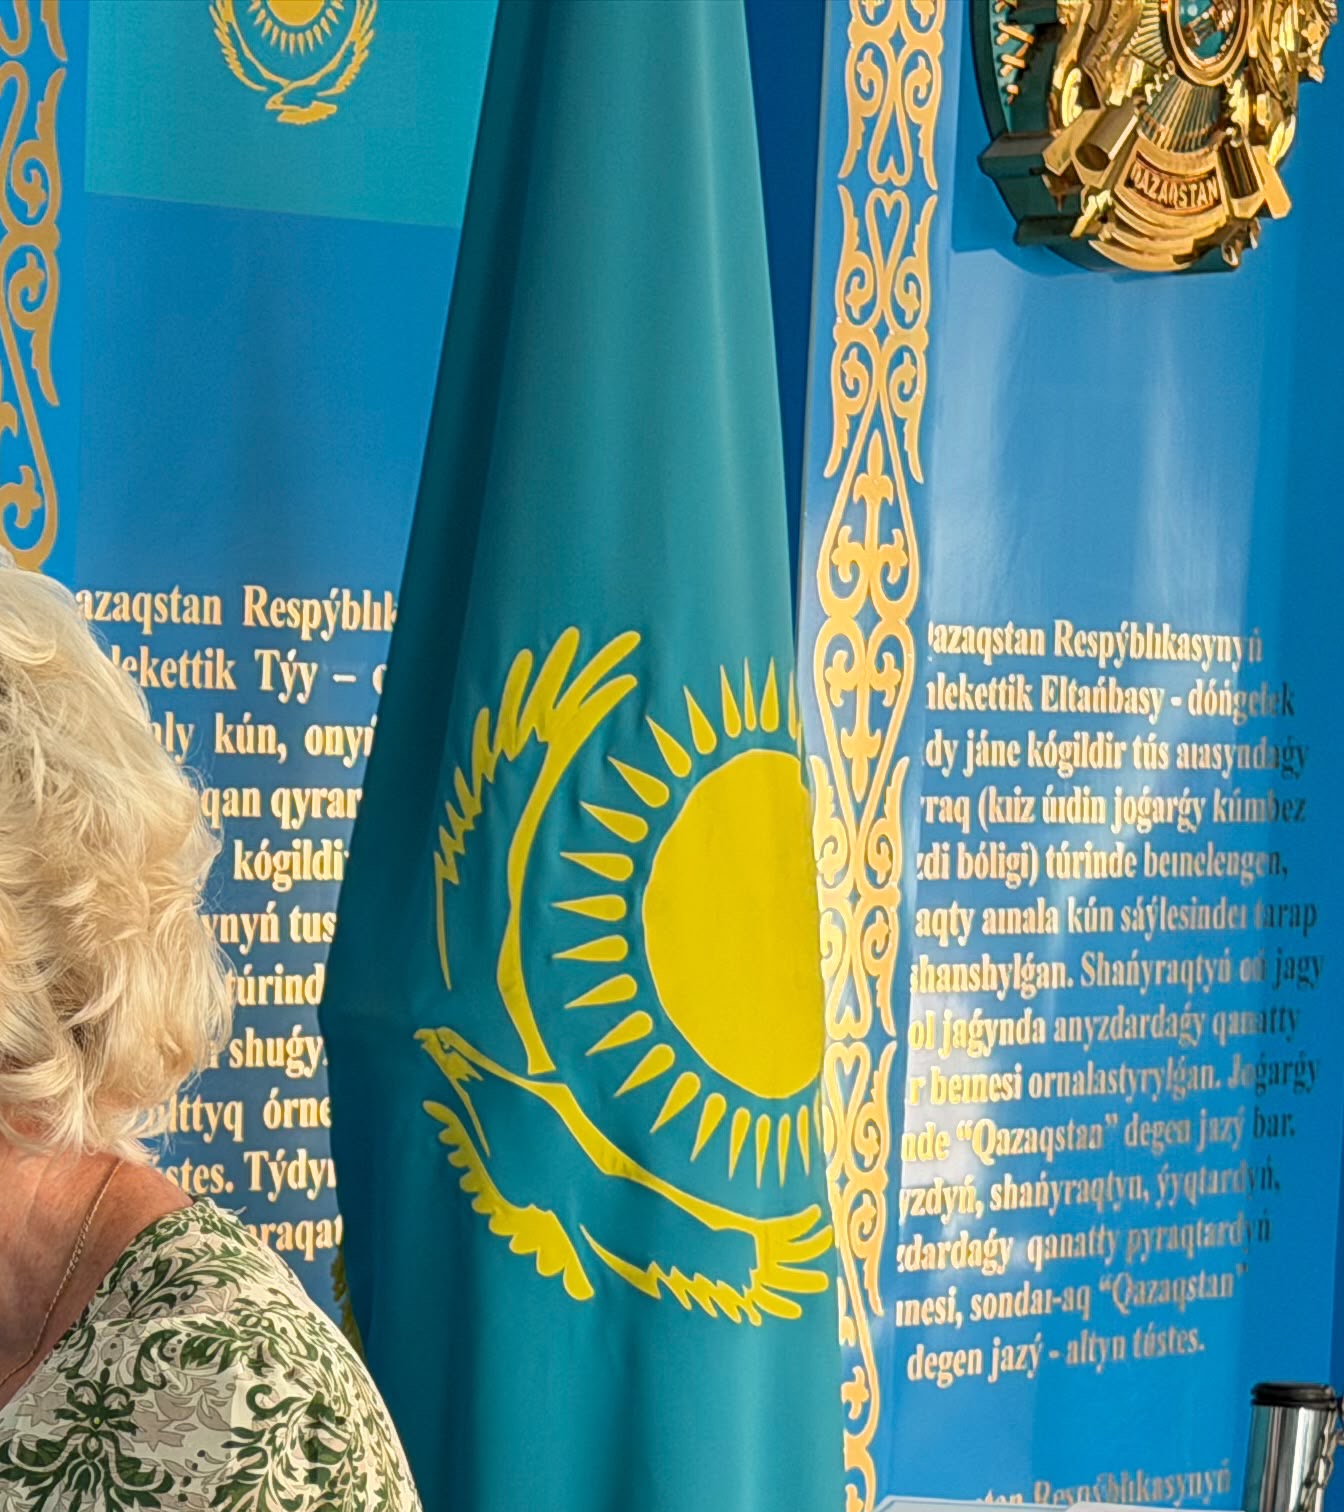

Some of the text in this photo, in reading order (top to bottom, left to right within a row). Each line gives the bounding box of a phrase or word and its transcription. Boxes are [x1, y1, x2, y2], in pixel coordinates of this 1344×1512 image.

[75, 584, 222, 635] azaqstan
[927, 620, 1046, 666] azaqstan
[214, 712, 288, 763] kún,
[962, 728, 1022, 778] jáne
[1027, 729, 1128, 779] kógildir
[1131, 732, 1170, 770] tús
[201, 787, 261, 829] qan
[1213, 787, 1307, 824] kúmbez
[233, 838, 350, 892] kógildi
[1045, 840, 1138, 880] túrinde
[915, 901, 975, 947] aqty
[1067, 896, 1114, 934] kún
[225, 962, 325, 1006] túrind
[1124, 1112, 1191, 1155] degen
[1027, 1223, 1119, 1272] qanatty
[906, 1343, 983, 1388] degen
[987, 1332, 1044, 1383] jazý
[1066, 1328, 1126, 1375] altyn
